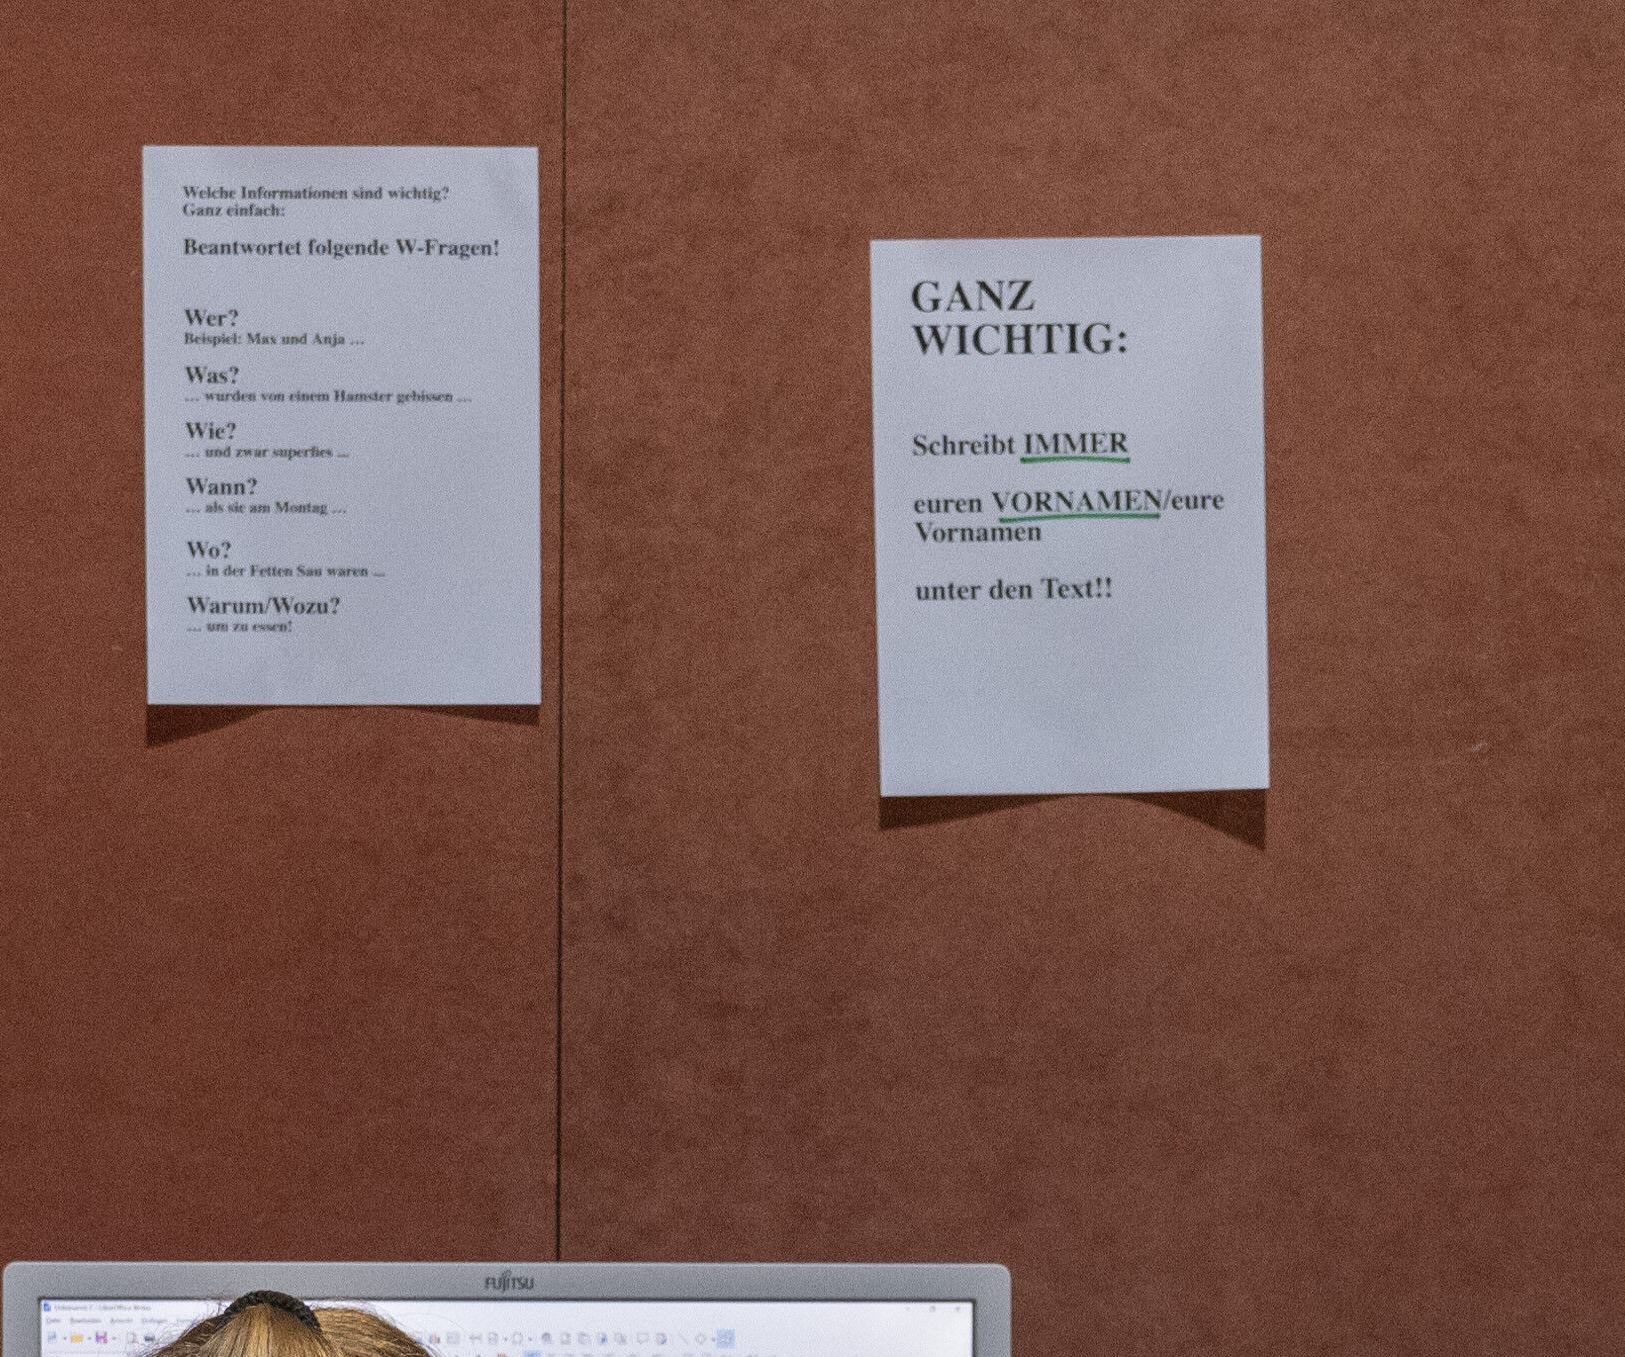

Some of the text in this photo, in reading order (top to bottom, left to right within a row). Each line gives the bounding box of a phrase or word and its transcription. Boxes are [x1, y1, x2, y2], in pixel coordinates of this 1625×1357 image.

[182, 185, 450, 203] Welche Informationen sind wichtig?
[181, 202, 286, 217] Ganz einfach:
[183, 237, 499, 260] Beantwortet folgende W-Fragen!
[910, 280, 1035, 312] GANZ
[184, 308, 239, 327] Wer?
[183, 331, 346, 348] Beispiel: Max und Anja
[912, 323, 1127, 356] WICHTIG:
[184, 365, 240, 385] Was?
[204, 389, 257, 403] wurden
[260, 392, 286, 403] von
[288, 390, 331, 403] einem
[333, 389, 394, 403] Hamster
[185, 421, 237, 440] Wie?
[204, 445, 232, 458] und
[235, 448, 270, 459] zwar
[912, 432, 1128, 456] Schreibt IMMER
[185, 477, 258, 496] Wann?
[204, 500, 329, 517] als sie am Montag
[913, 489, 1225, 514] euren VORNAMEN/eure
[915, 521, 1042, 543] Vornamen
[186, 540, 232, 559] Wo?
[205, 564, 219, 577] in
[222, 564, 246, 577] der
[249, 564, 294, 578] Fetten
[326, 567, 369, 578] waren
[915, 576, 1112, 602] unter den Text!!
[187, 596, 341, 615] Warum/Wozu?
[205, 622, 229, 633] um
[251, 619, 293, 633] essen!
[484, 1273, 535, 1294] FUJITSU
